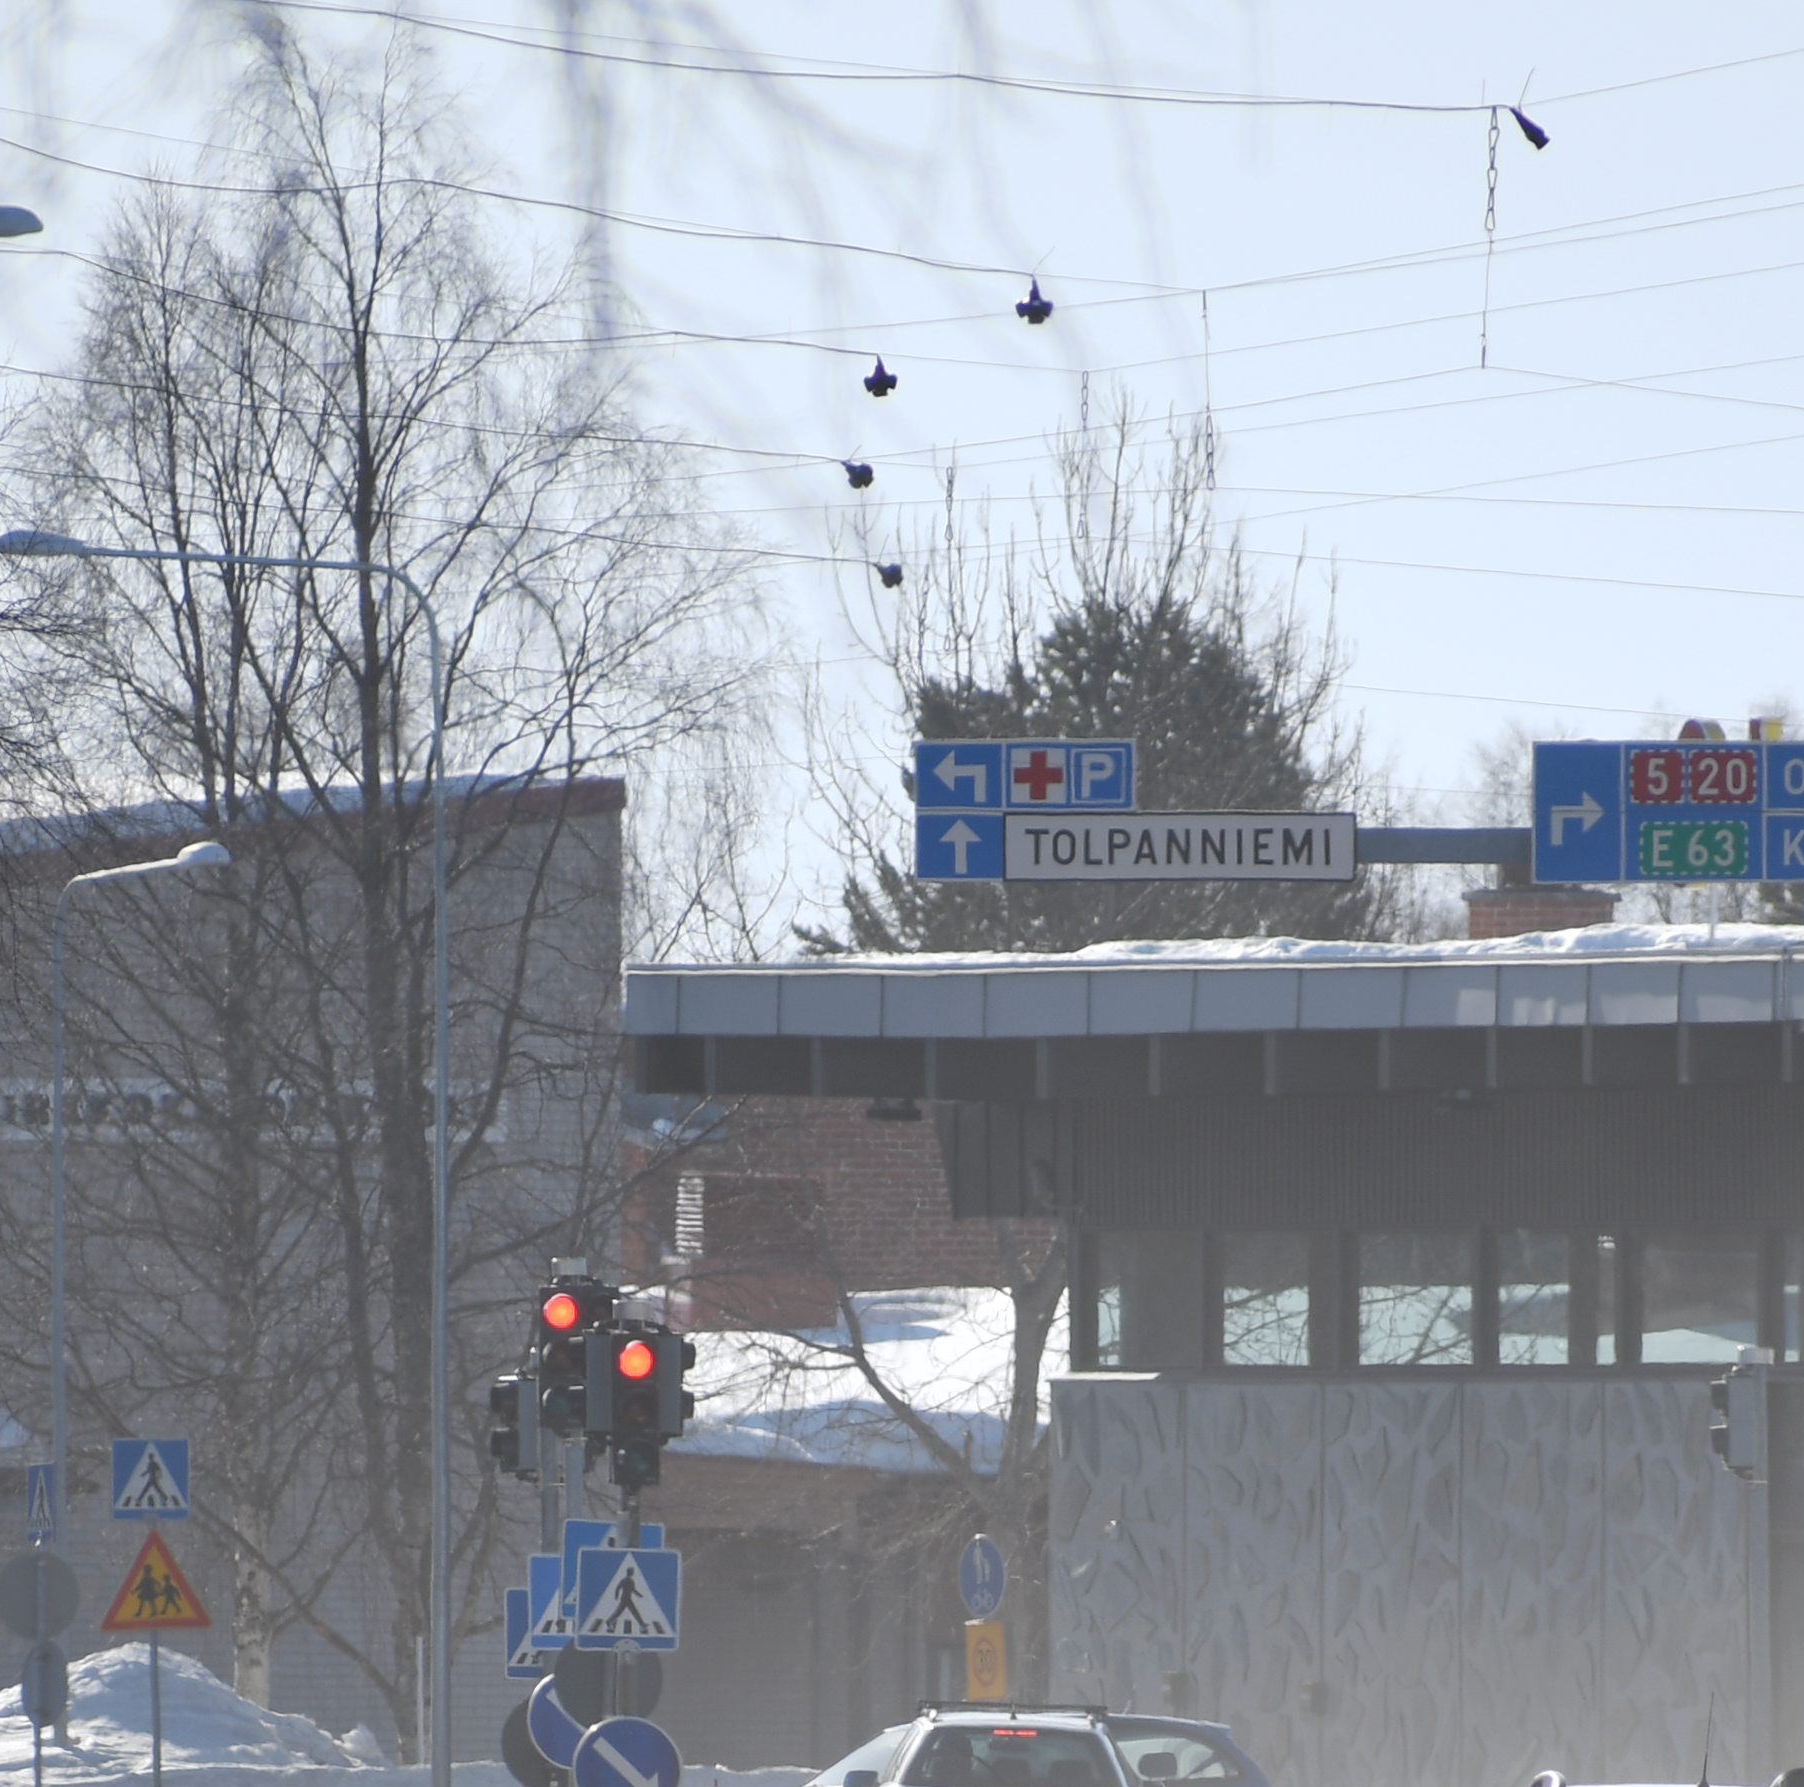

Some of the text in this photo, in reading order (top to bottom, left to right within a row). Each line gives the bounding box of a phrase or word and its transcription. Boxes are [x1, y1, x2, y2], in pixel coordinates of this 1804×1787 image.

[1081, 752, 1115, 799] P
[1646, 757, 1748, 796] 5 20
[1024, 827, 1332, 867] TOLPANNIEMI
